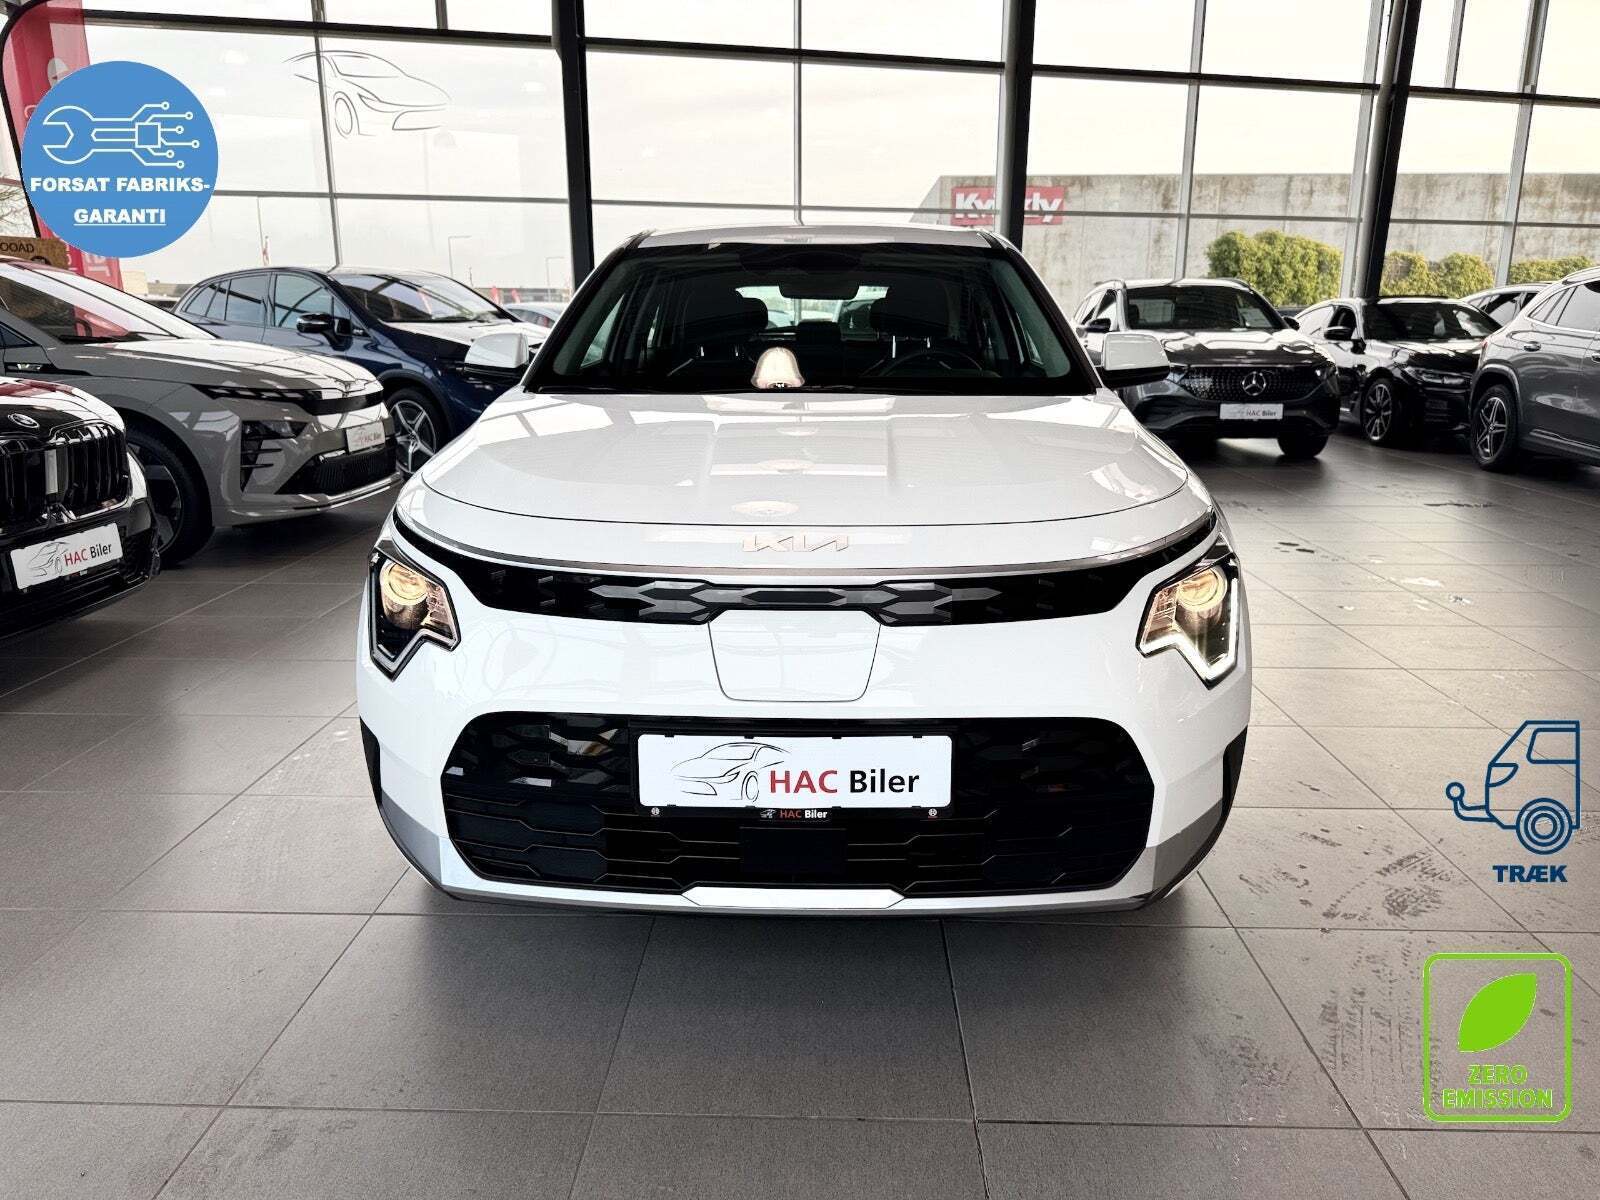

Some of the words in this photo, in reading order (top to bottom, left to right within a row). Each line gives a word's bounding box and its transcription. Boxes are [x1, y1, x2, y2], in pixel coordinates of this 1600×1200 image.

[64, 548, 88, 566] HAC
[89, 542, 112, 558] Biler
[770, 770, 838, 794] HAC
[850, 768, 920, 793] Biler
[779, 809, 802, 819] HAC
[804, 808, 828, 819] Biler
